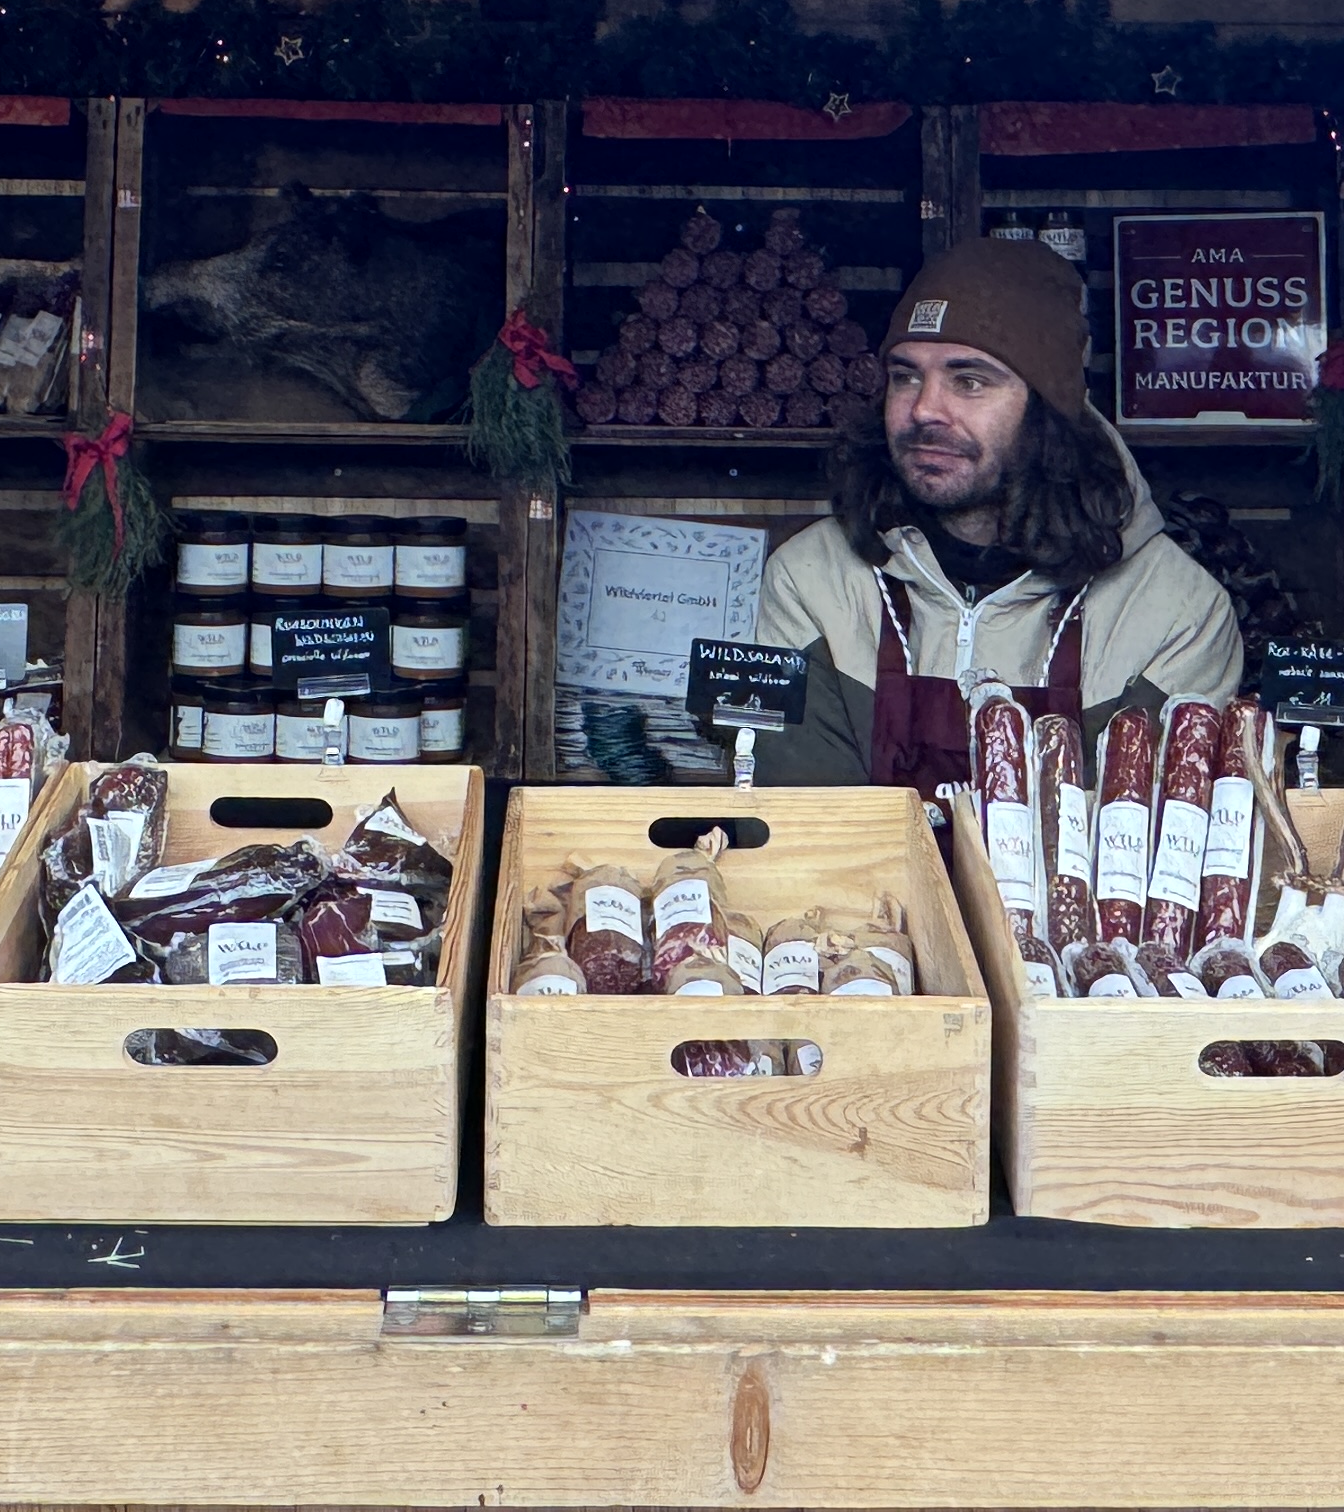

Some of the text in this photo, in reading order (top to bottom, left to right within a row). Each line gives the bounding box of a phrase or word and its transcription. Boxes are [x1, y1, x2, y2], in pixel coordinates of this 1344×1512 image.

[1192, 248, 1244, 263] AMA
[1130, 277, 1308, 309] GENUSS
[1133, 319, 1306, 349] REGION
[1135, 371, 1307, 389] MANUFAKTUR
